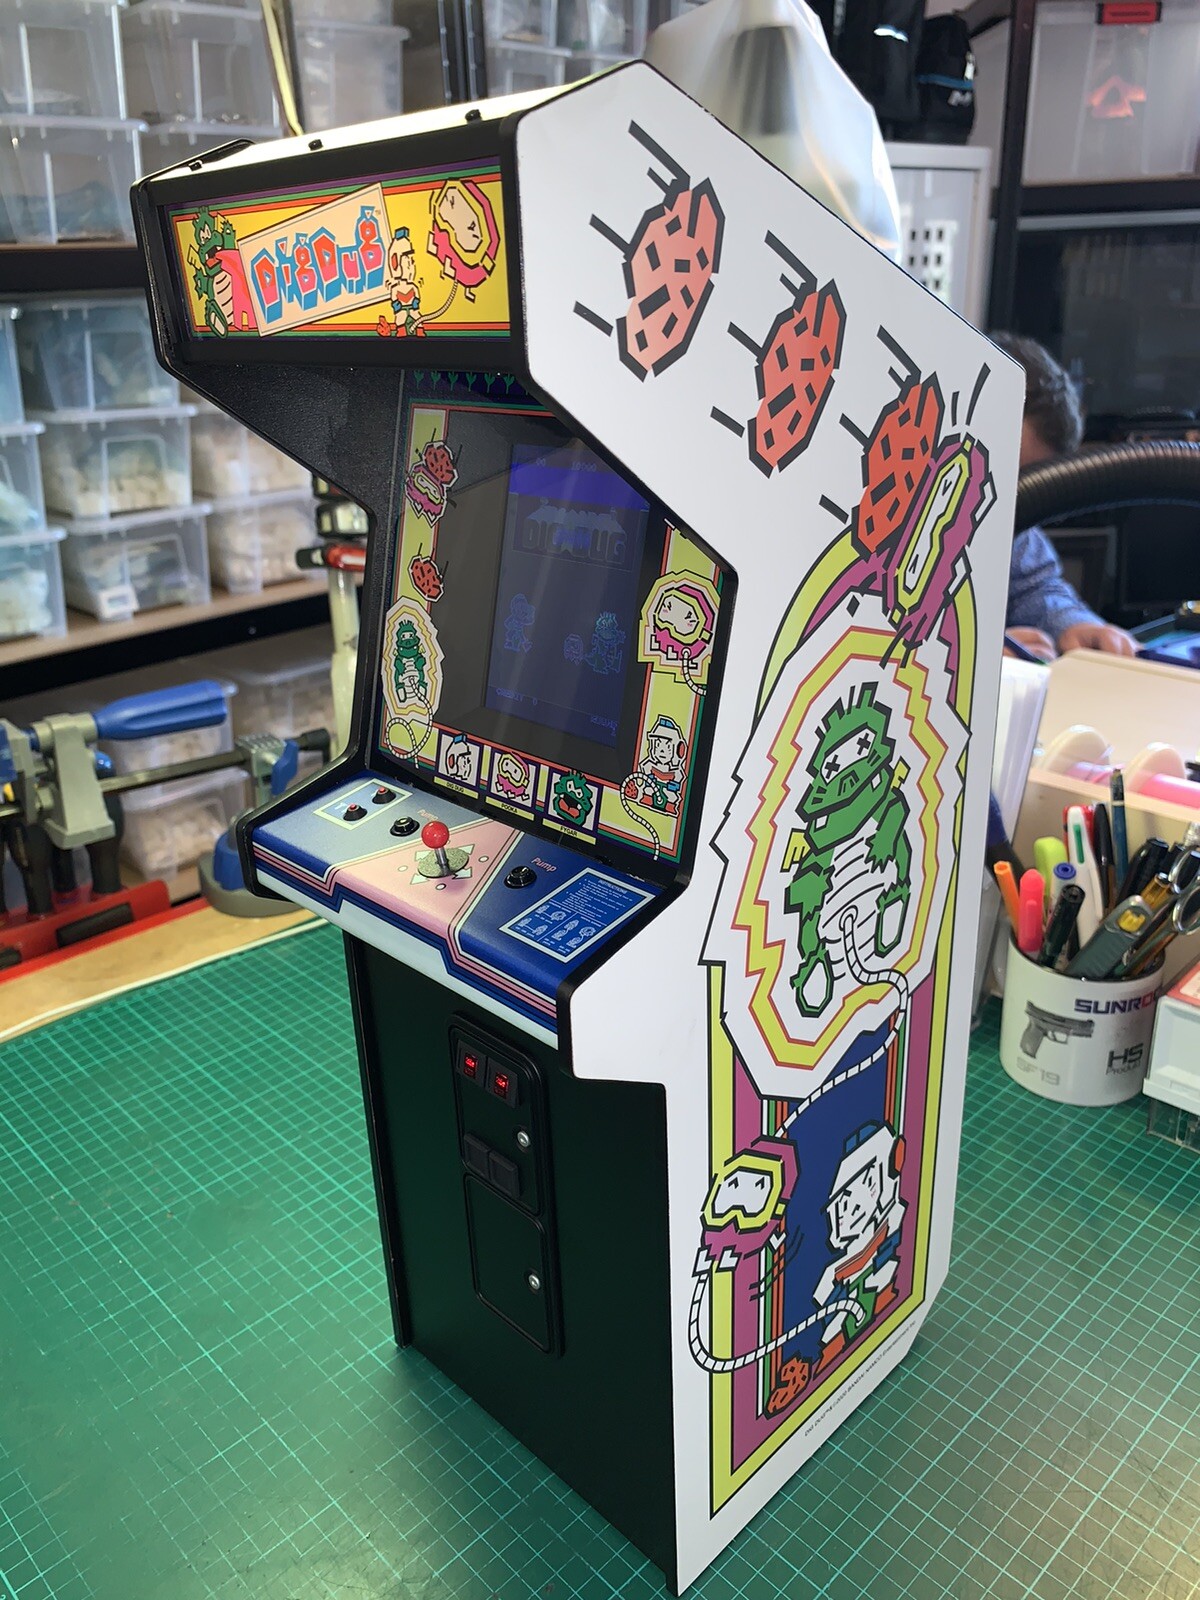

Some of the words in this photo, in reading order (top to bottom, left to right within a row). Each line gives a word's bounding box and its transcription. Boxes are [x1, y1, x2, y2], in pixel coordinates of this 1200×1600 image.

[446, 781, 455, 789] DIG
[455, 784, 465, 793] DUG
[501, 803, 518, 814] POOKA
[560, 826, 578, 837] FYGAR
[531, 857, 557, 872] Pump
[1107, 1042, 1144, 1068] HS
